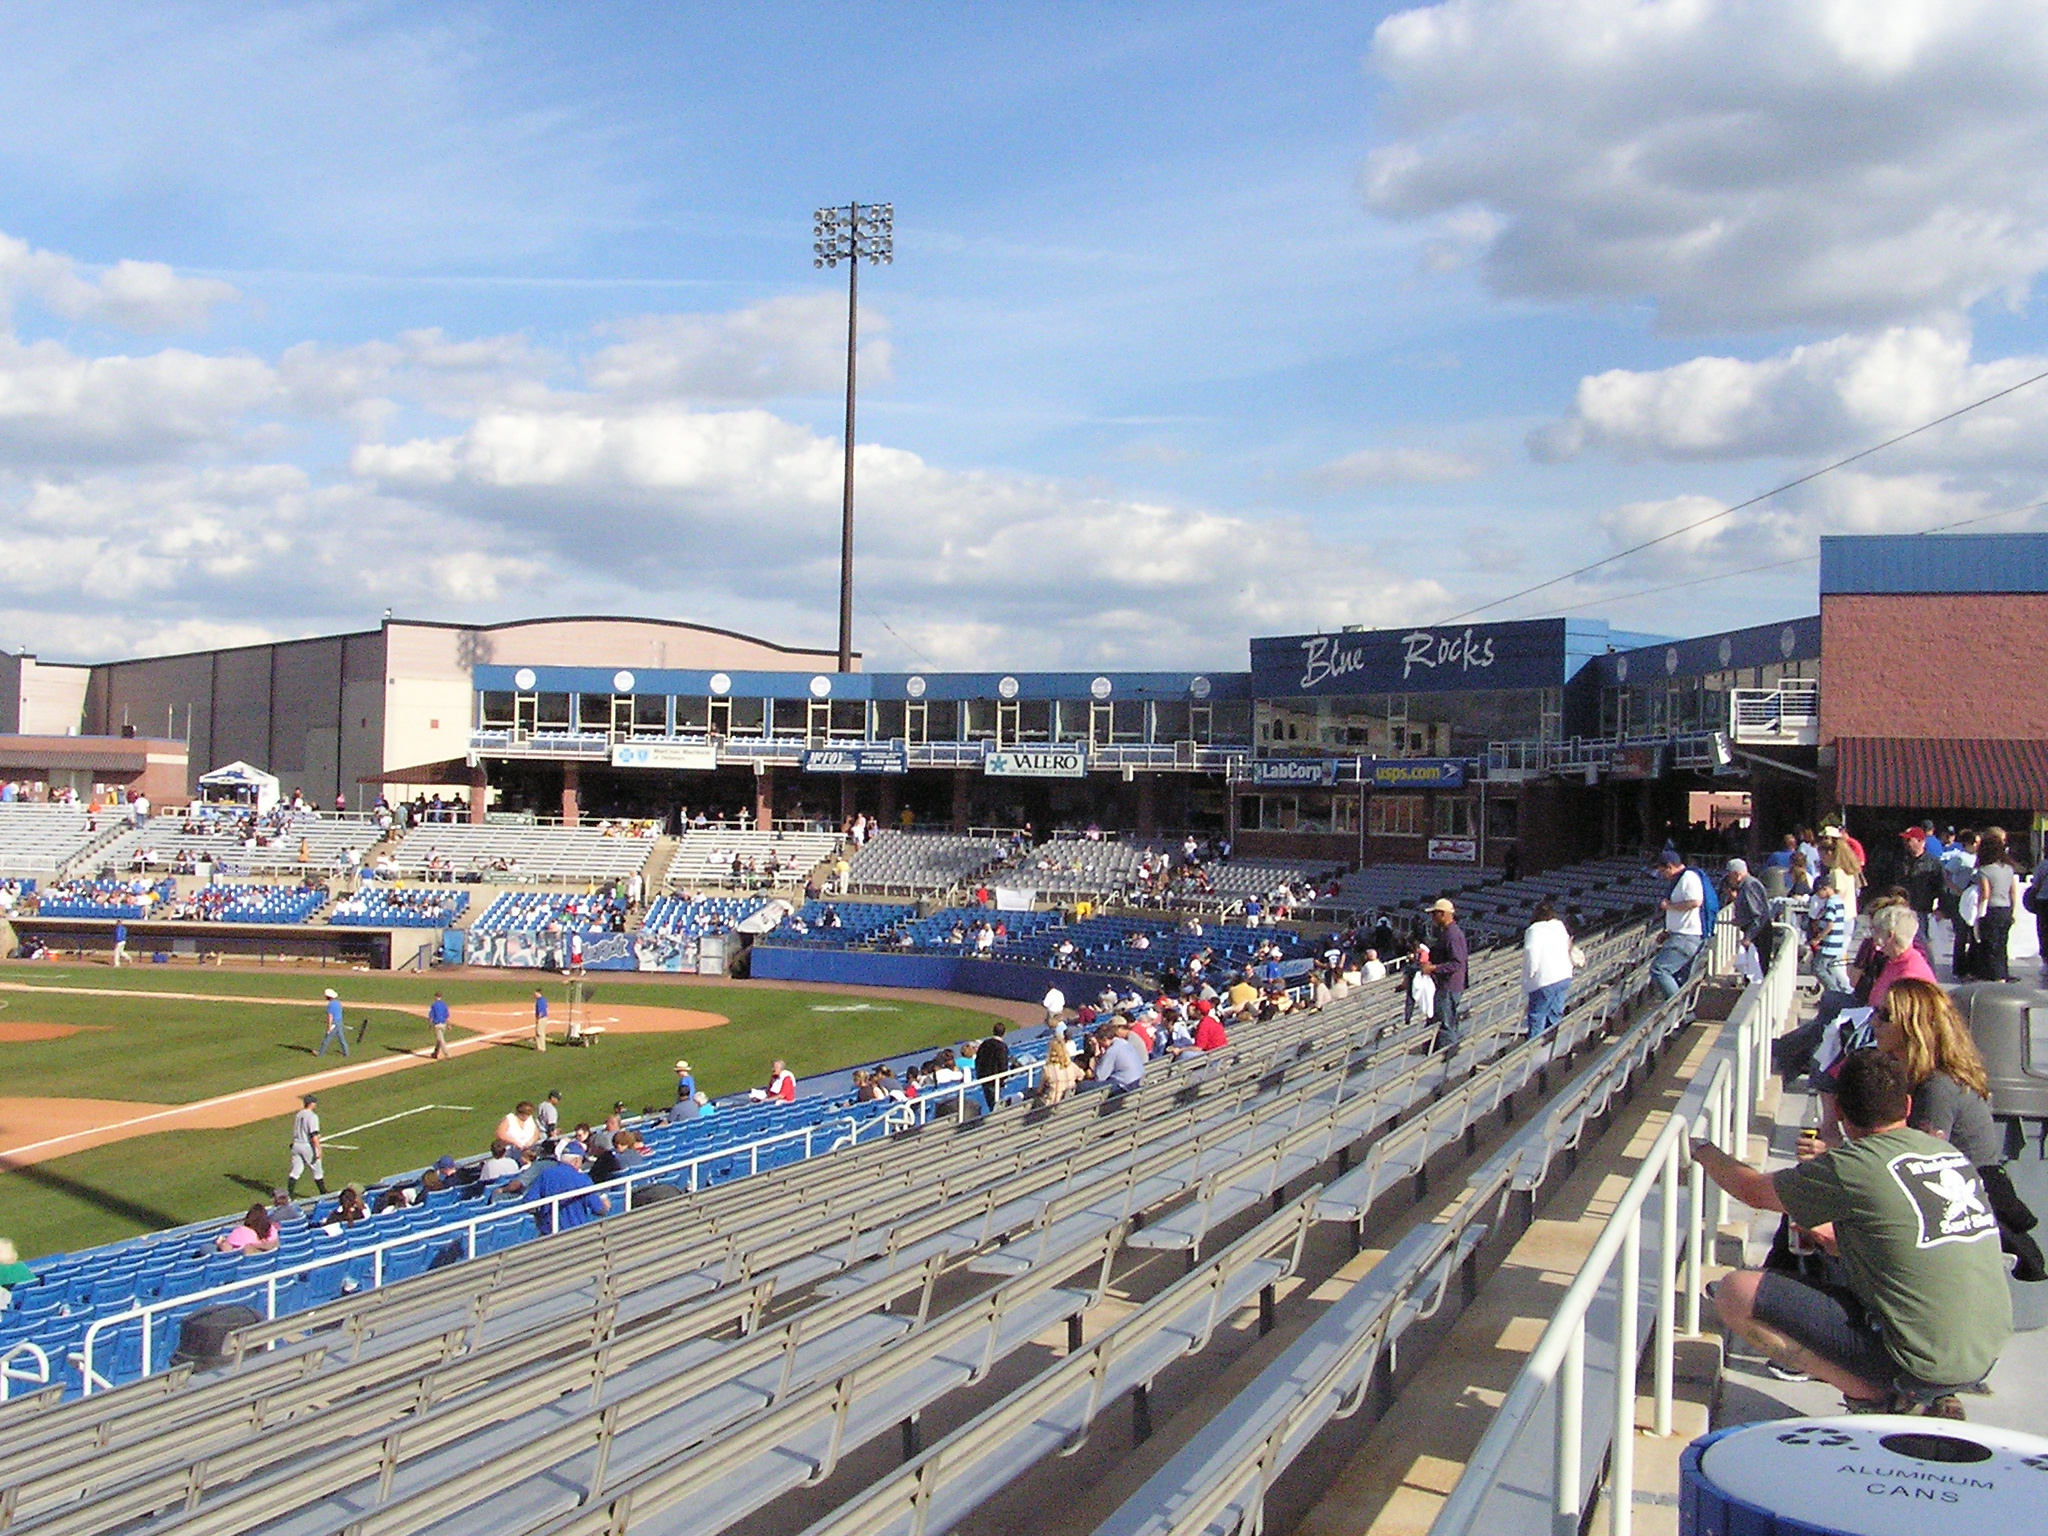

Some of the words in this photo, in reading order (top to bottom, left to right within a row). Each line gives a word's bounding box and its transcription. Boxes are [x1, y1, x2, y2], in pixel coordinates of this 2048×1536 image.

[1301, 636, 1365, 689] Blue
[1401, 627, 1495, 680] Rocks
[1013, 754, 1078, 770] VALERO
[1262, 763, 1322, 780] LabCorp
[1376, 767, 1441, 783] usps.com
[1836, 1465, 1995, 1490] ALUMINUM
[1866, 1483, 1959, 1503] CANS
